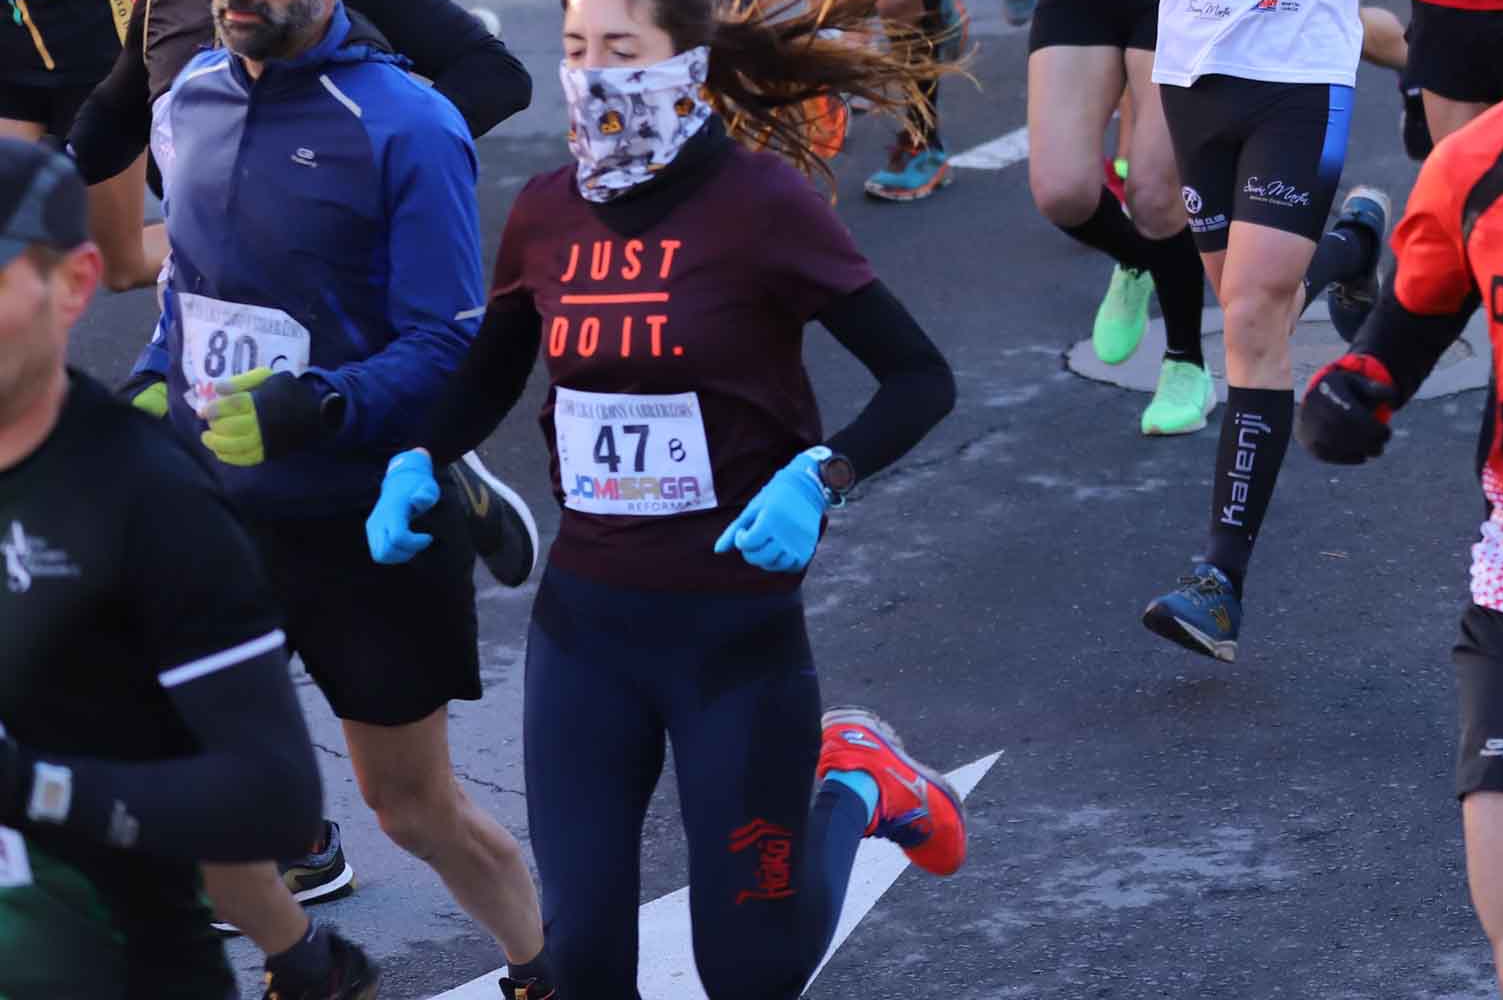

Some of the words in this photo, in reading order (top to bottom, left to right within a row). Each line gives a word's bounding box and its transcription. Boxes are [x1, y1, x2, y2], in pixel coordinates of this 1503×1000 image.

[560, 239, 682, 283] JUST
[548, 315, 600, 358] DO
[619, 314, 684, 358] IT.
[592, 424, 650, 473] 47
[569, 473, 702, 501] JOMISAGA
